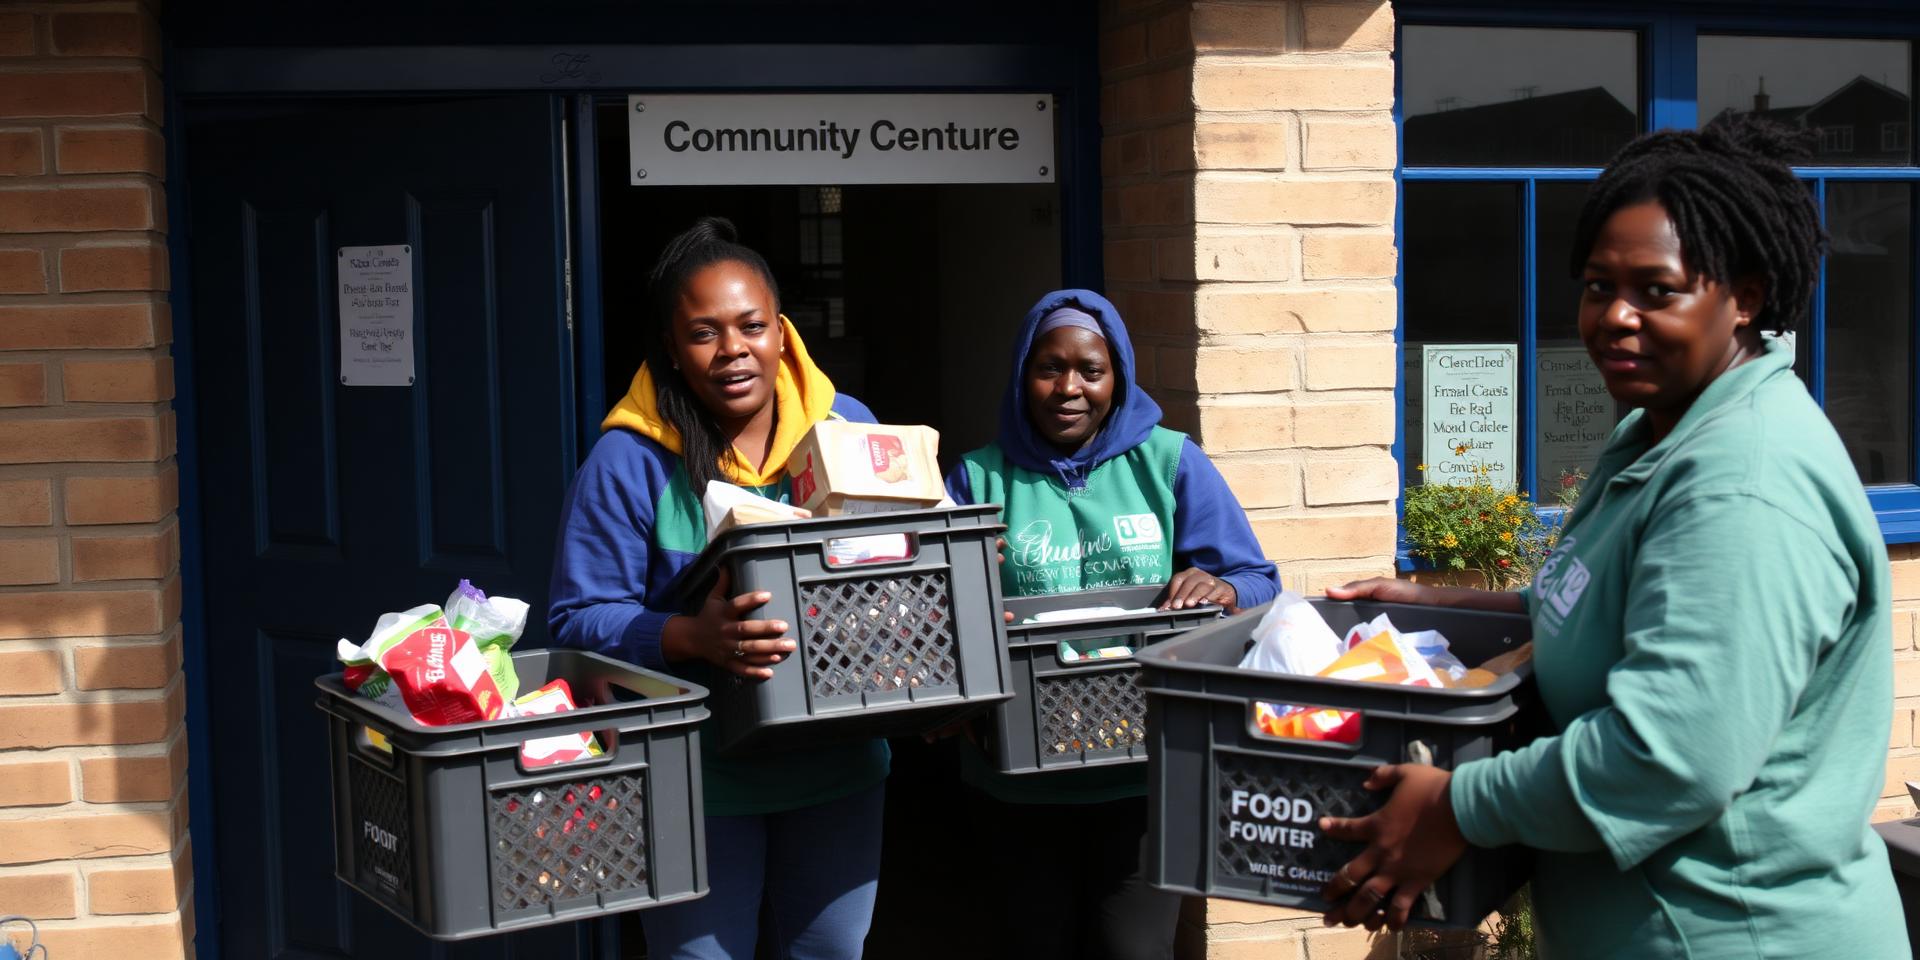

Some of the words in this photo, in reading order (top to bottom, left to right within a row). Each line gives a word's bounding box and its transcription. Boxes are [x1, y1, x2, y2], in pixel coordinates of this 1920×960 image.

[663, 119, 860, 159] Comnunity
[870, 119, 1020, 151] Centure
[1231, 789, 1313, 824] FOOD
[1229, 820, 1315, 849] FOWTER
